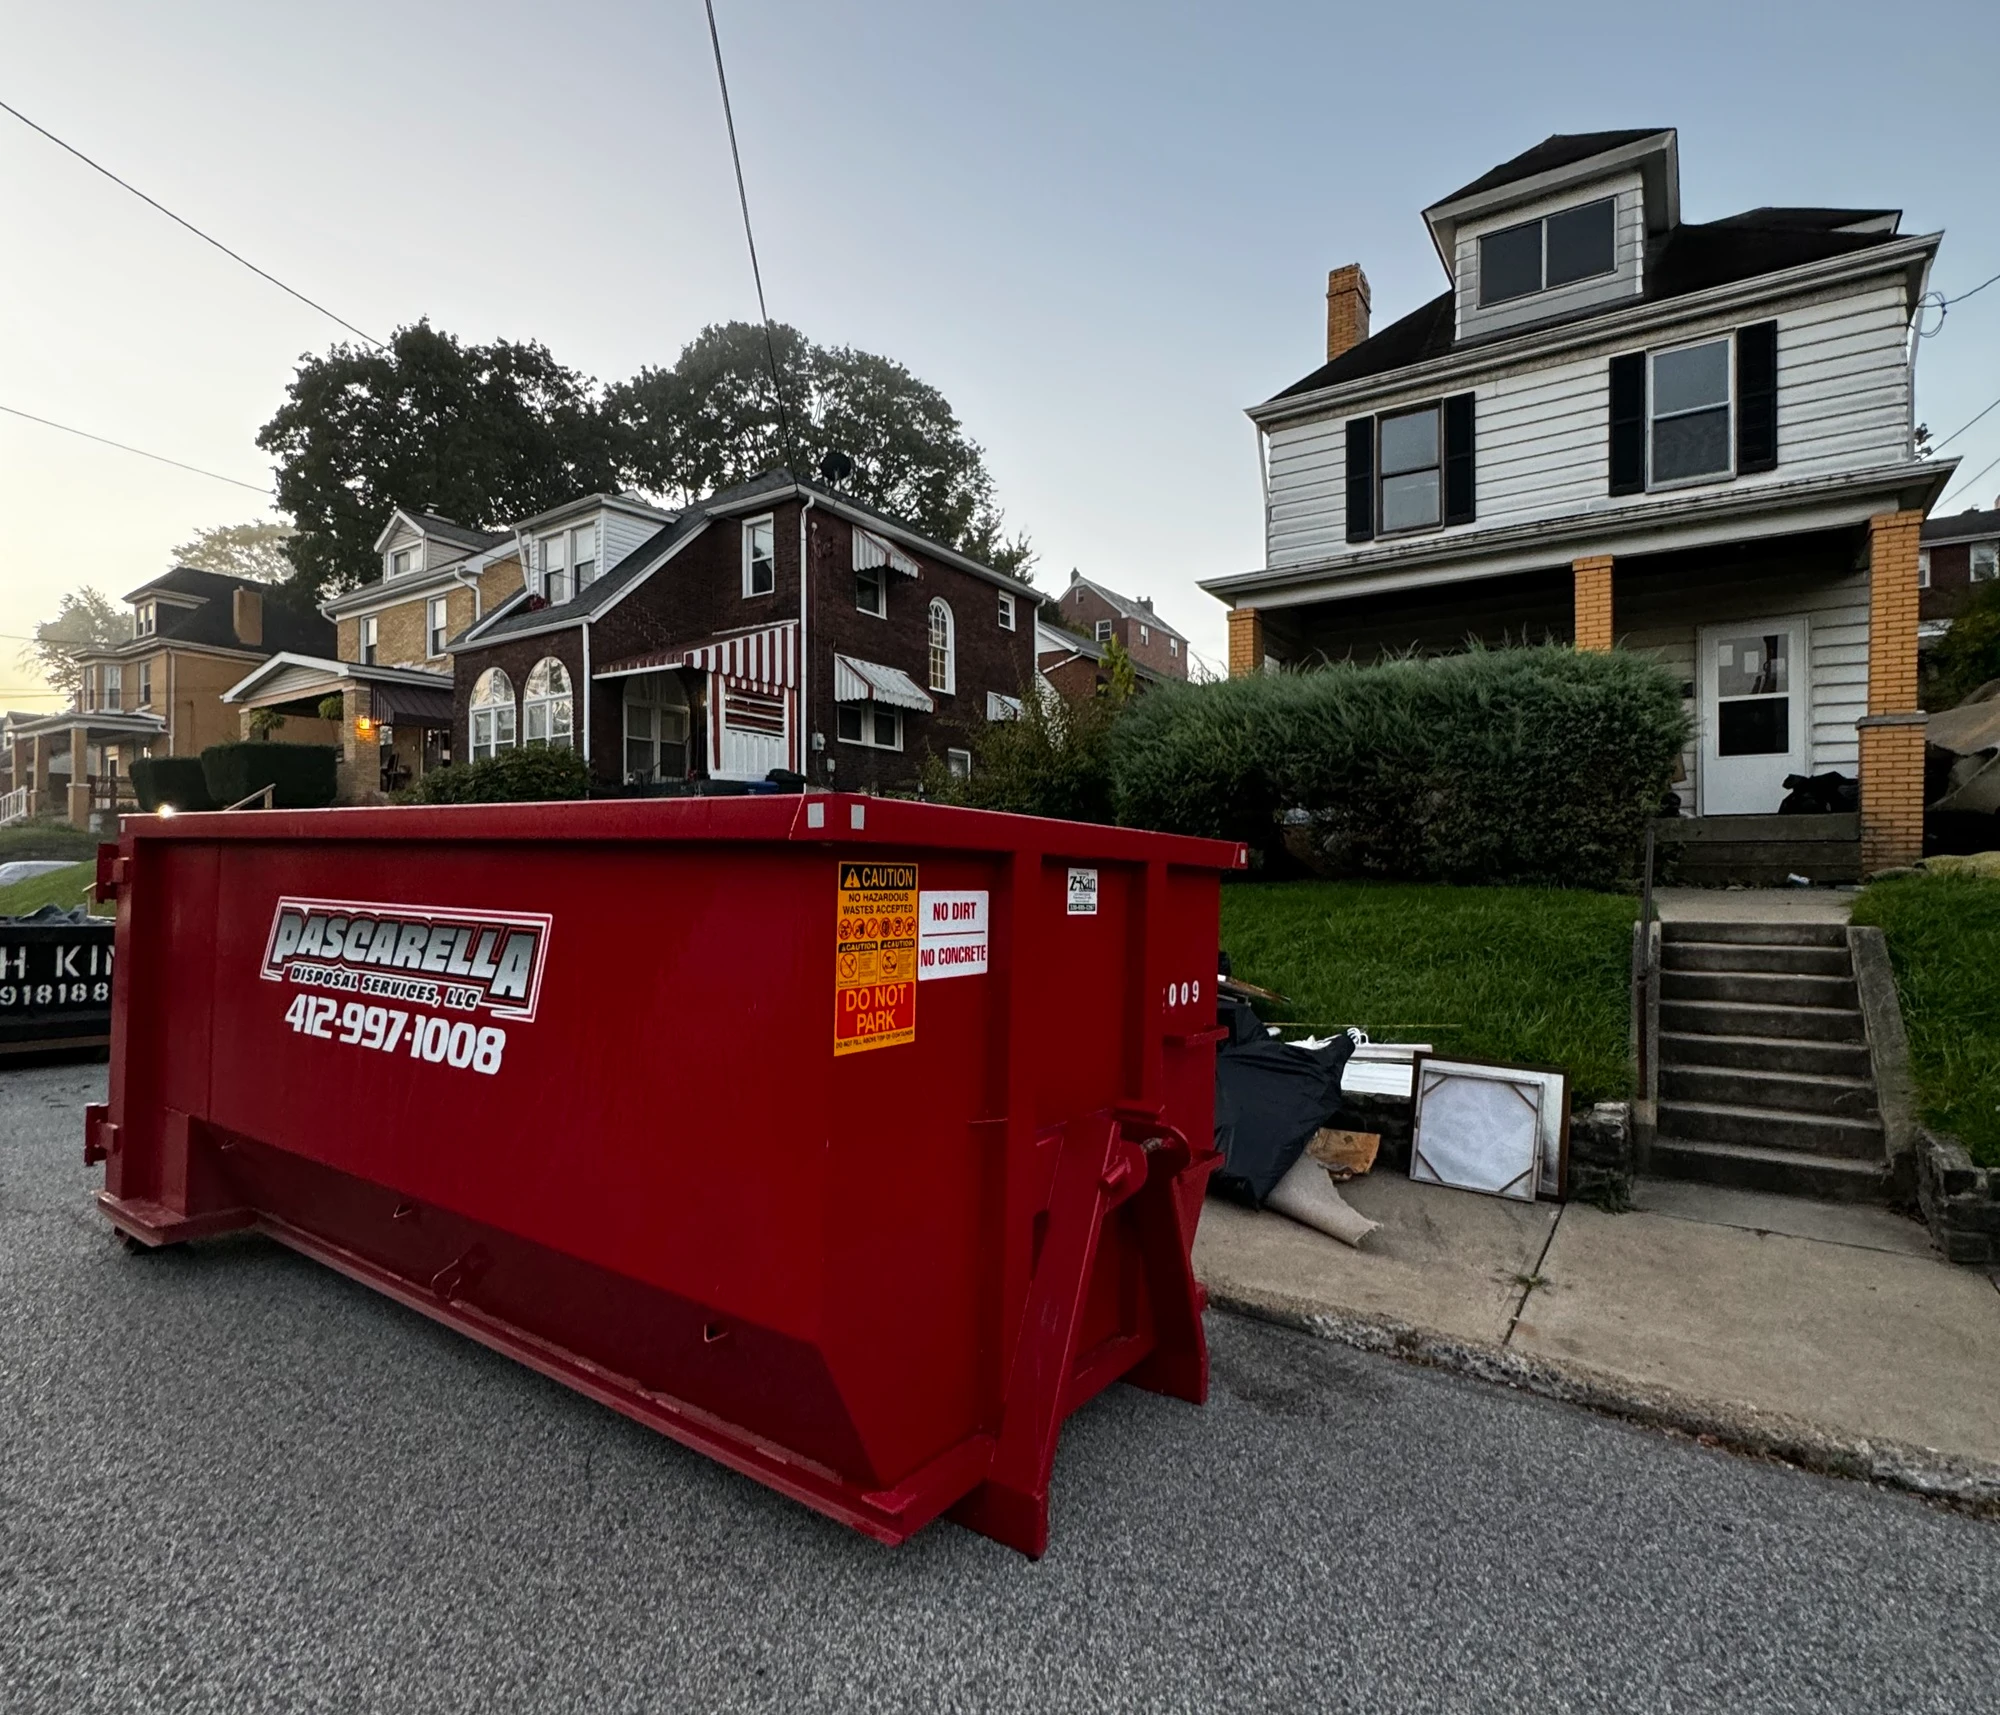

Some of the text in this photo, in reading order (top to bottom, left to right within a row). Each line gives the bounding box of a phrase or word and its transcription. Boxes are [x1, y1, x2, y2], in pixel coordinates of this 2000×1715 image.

[862, 867, 913, 887] CAUTION
[848, 892, 909, 902] NO HAZARDOUS
[842, 904, 913, 915] WASTES ACCEPTED
[933, 902, 977, 921] NO DIRT
[846, 943, 876, 951] CAUTION
[887, 940, 914, 948] CAUTION
[270, 911, 537, 999] PASCARELLA
[920, 949, 935, 967] NO
[938, 945, 987, 964] CONCRETE
[290, 967, 479, 1009] DISPOSAL SERVICES, LLC
[845, 984, 907, 1012] DO NOT
[857, 1009, 896, 1035] PARK
